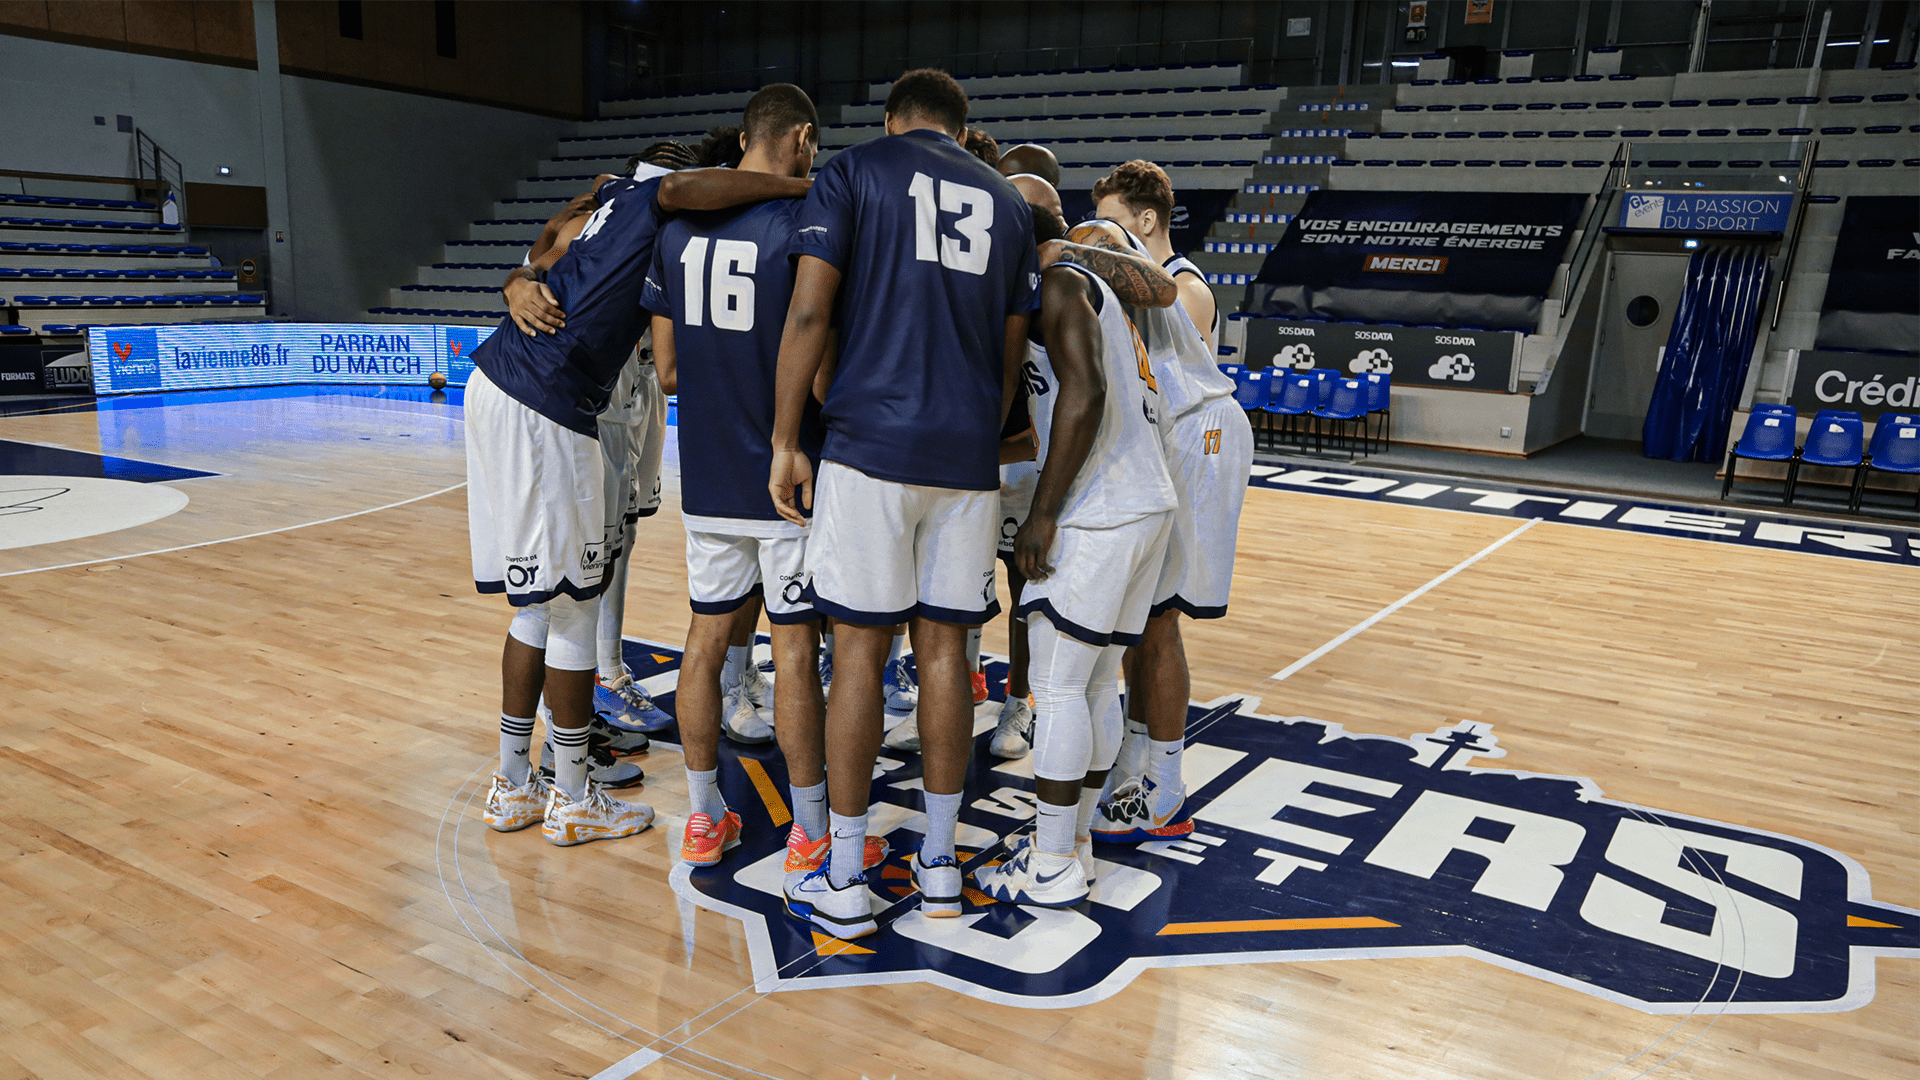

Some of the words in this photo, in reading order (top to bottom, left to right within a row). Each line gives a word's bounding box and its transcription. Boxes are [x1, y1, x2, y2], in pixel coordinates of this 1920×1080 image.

[1630, 195, 1650, 209] GL
[1666, 199, 1689, 213] LA
[1695, 199, 1780, 214] PASSION
[908, 171, 994, 276] 13
[1299, 219, 1341, 231] VOS
[1344, 220, 1563, 236] ENCOURAGEMENTS
[1664, 216, 1690, 230] DU
[1695, 216, 1760, 231] SPORT
[1300, 233, 1361, 244] SONT
[1363, 235, 1440, 247] NOTRE
[1442, 235, 1545, 250] ÉNERGIE
[1369, 256, 1441, 272] MERCI
[680, 236, 758, 331] 16
[1278, 326, 1294, 335] SOS
[1294, 328, 1315, 337] DATA
[1354, 330, 1371, 340] SOS
[1371, 332, 1393, 342] DATA
[320, 334, 410, 353] PARRAIN
[1435, 335, 1452, 345] SOS
[1452, 337, 1476, 347] DATA
[174, 343, 290, 370] lavienne86.fr
[312, 355, 341, 374] DU
[347, 355, 421, 375] MATCH
[1, 372, 36, 381] FORMATS
[1204, 429, 1222, 455] 17
